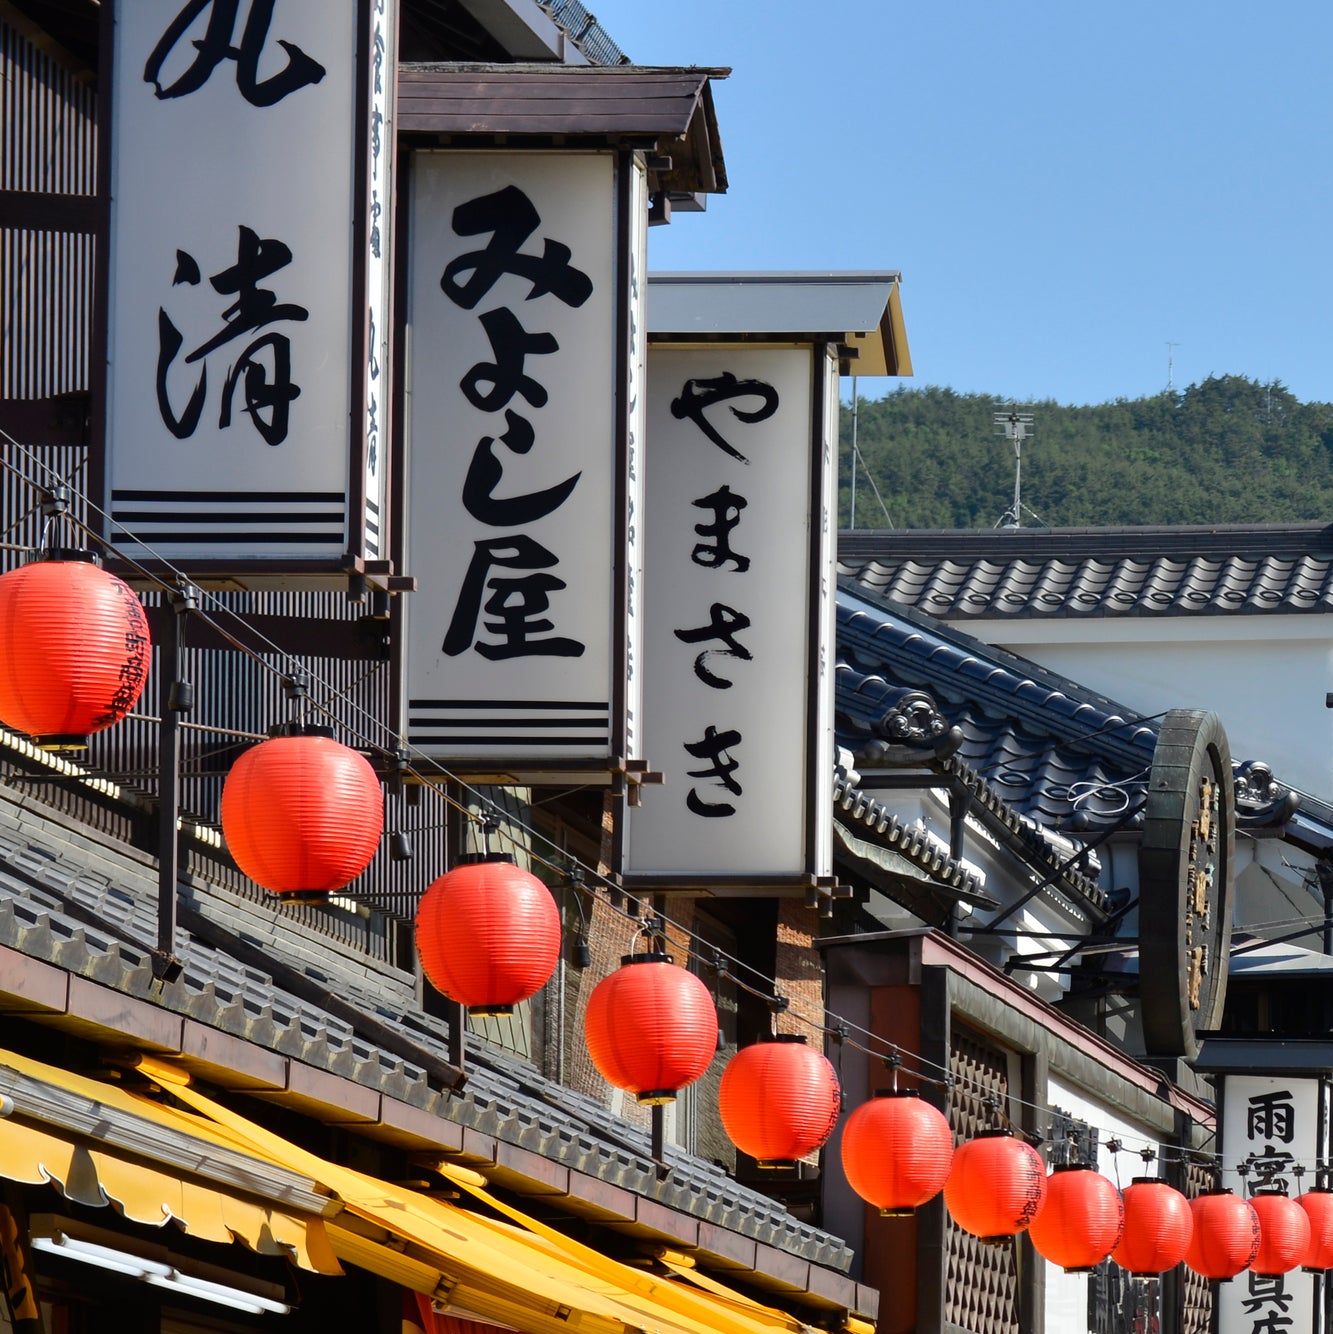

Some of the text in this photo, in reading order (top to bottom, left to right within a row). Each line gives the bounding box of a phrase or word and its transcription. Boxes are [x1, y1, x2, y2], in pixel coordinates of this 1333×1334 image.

[440, 185, 594, 661] みよし屋
[670, 371, 779, 818] やまさき
